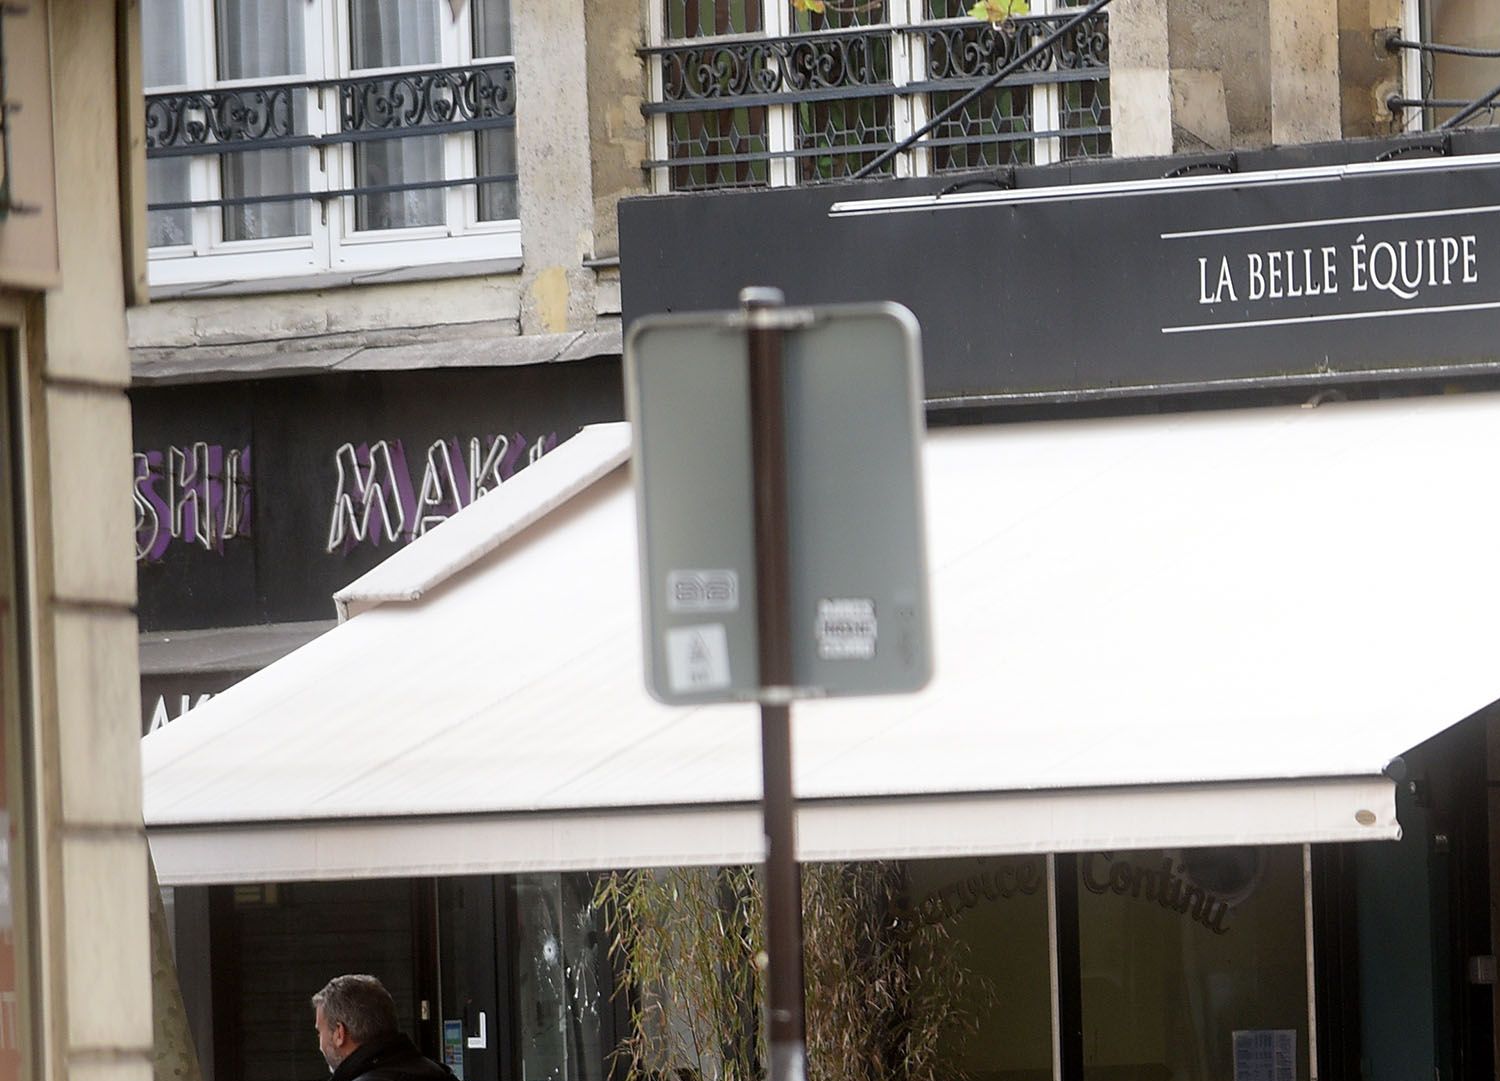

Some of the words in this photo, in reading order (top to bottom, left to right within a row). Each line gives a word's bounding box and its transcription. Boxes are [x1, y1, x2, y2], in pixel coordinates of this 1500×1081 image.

[1198, 255, 1238, 304] LA
[1248, 246, 1338, 300] BELLE
[1351, 233, 1478, 299] ÉQUIPE
